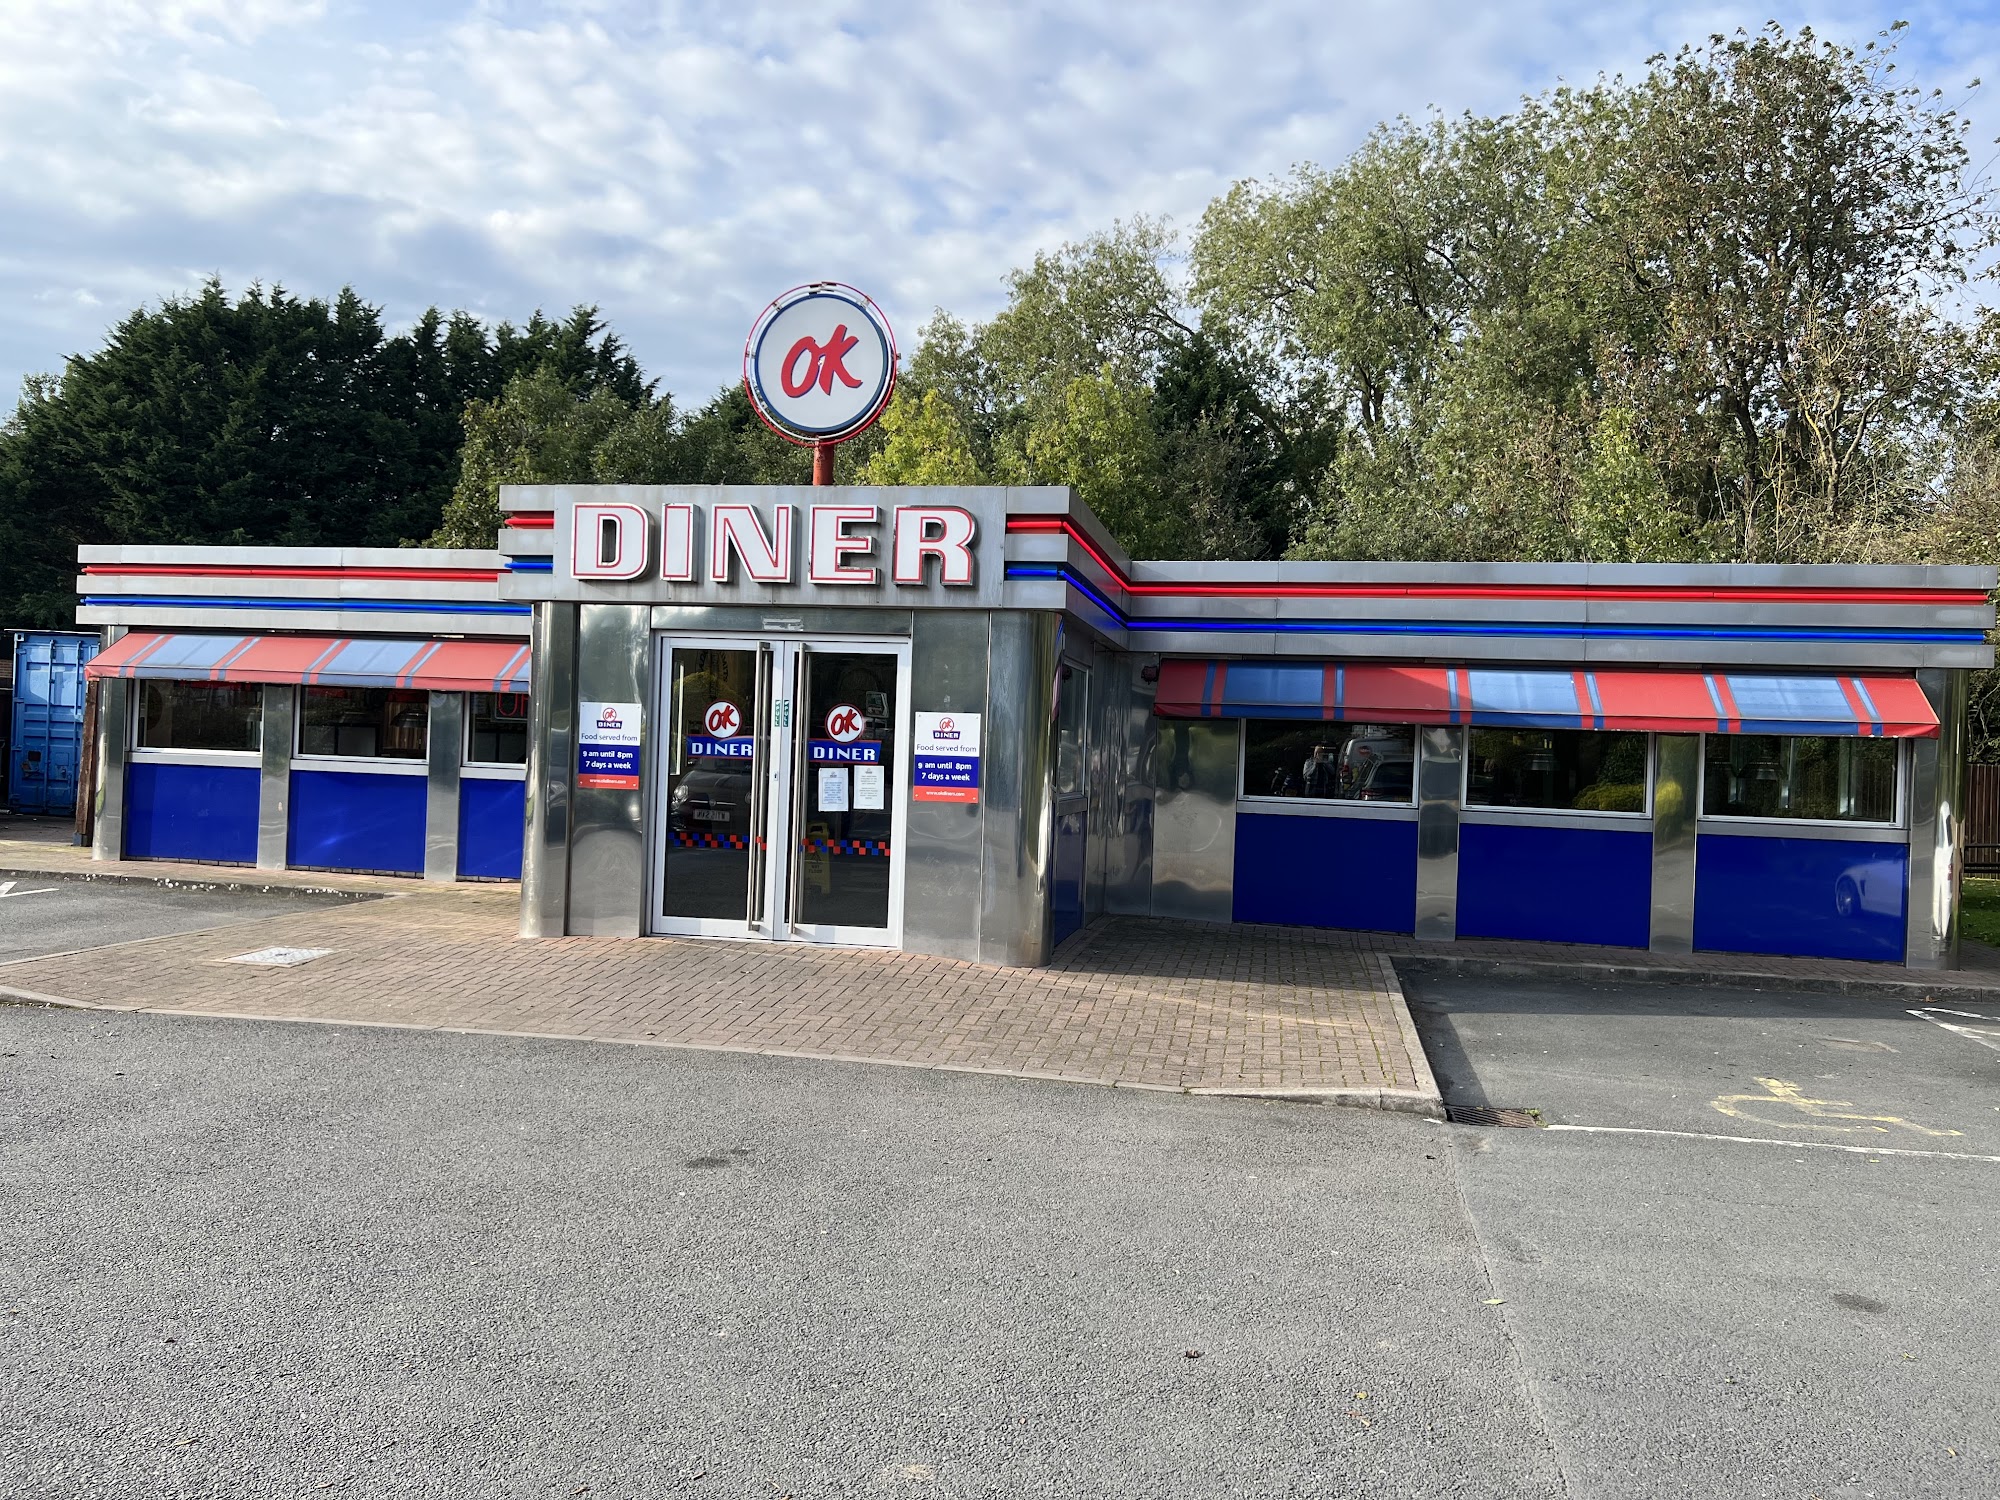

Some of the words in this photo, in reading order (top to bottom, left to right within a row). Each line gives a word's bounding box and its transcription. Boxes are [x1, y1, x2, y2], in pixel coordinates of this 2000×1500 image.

[781, 323, 863, 398] OK
[570, 502, 978, 587] DINER
[708, 704, 737, 732] OK
[831, 709, 860, 736] OK
[622, 734, 638, 742] from
[691, 743, 753, 757] DINER
[813, 746, 876, 761] DINER
[916, 743, 934, 751] Food
[960, 745, 977, 753] from
[591, 761, 607, 770] days
[937, 761, 953, 769] until
[955, 762, 972, 771] 8pm
[928, 772, 944, 781] days
[951, 773, 971, 781] week
